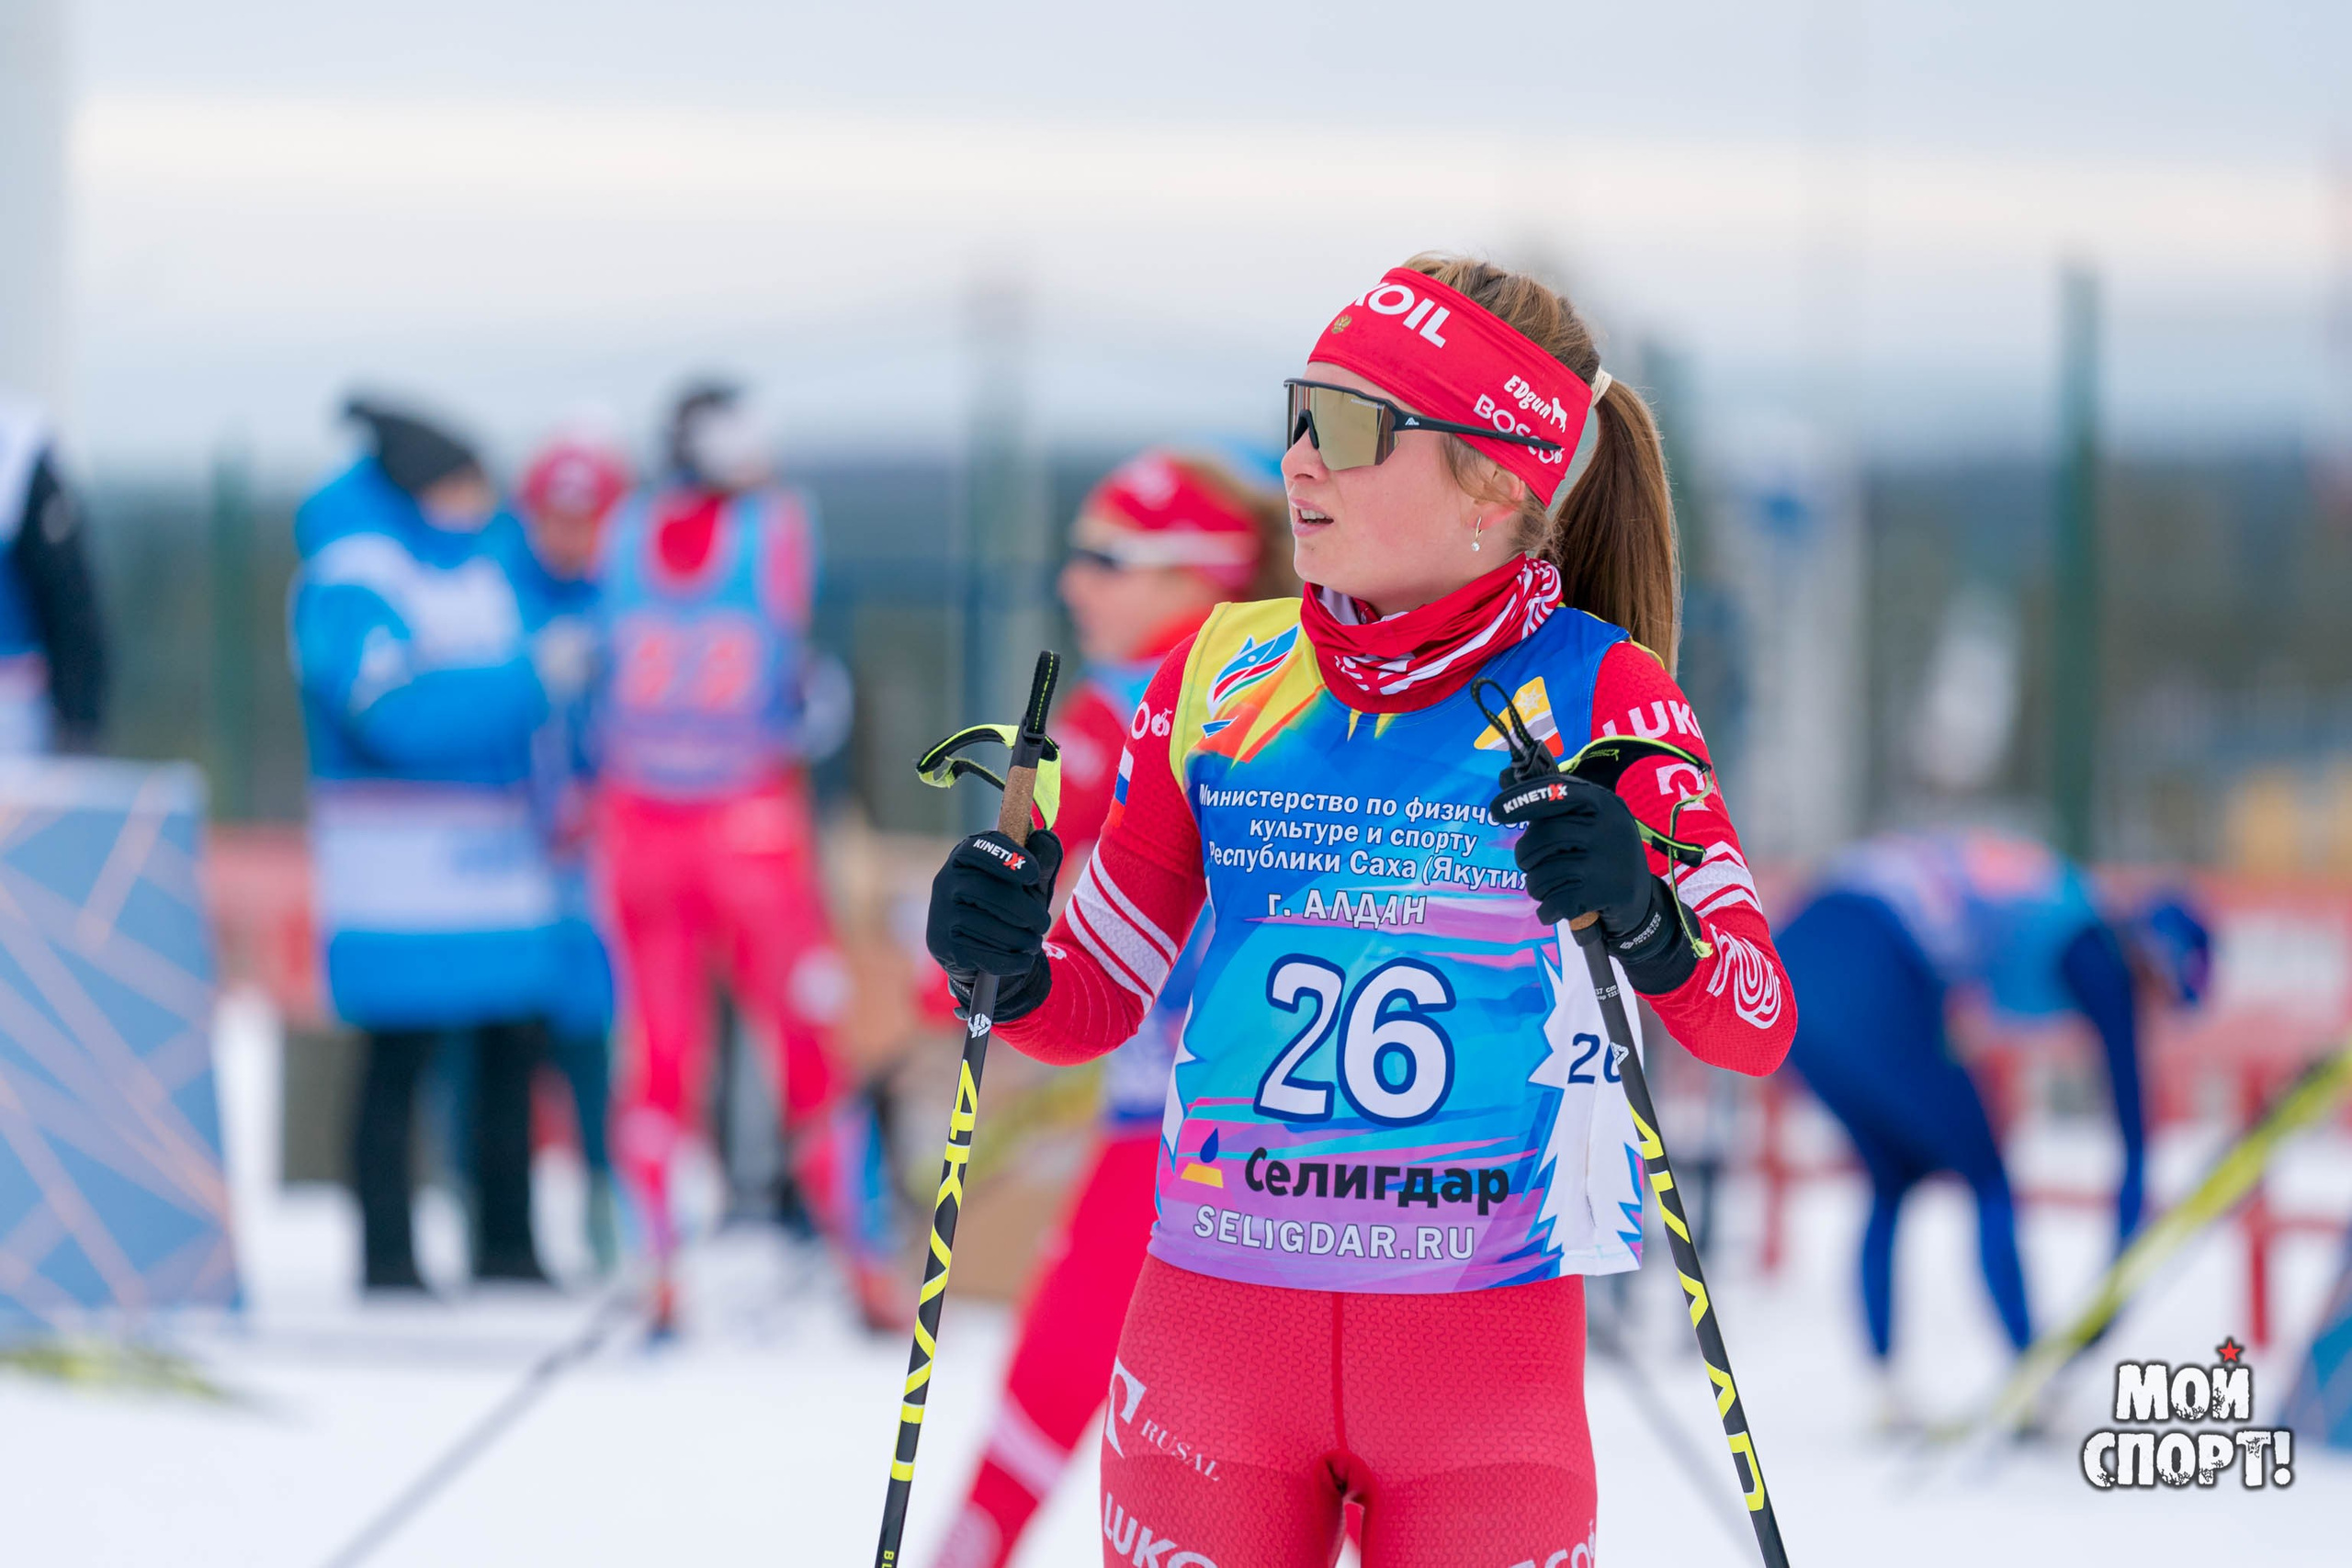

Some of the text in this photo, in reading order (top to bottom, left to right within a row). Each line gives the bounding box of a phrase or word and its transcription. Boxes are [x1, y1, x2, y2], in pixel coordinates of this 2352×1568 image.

[1199, 783, 1531, 830] Министерство по физич
[1208, 840, 1342, 874] Республики
[1349, 850, 1418, 879] Саха
[1249, 818, 1478, 857] культуре и спорту
[1267, 888, 1427, 930] г. АЛДАН
[1253, 953, 1459, 1128] 26
[1245, 1146, 1510, 1215] Селигдар
[1193, 1205, 1475, 1260] SELIGDAR.RU
[1140, 1418, 1220, 1482] RUSAL
